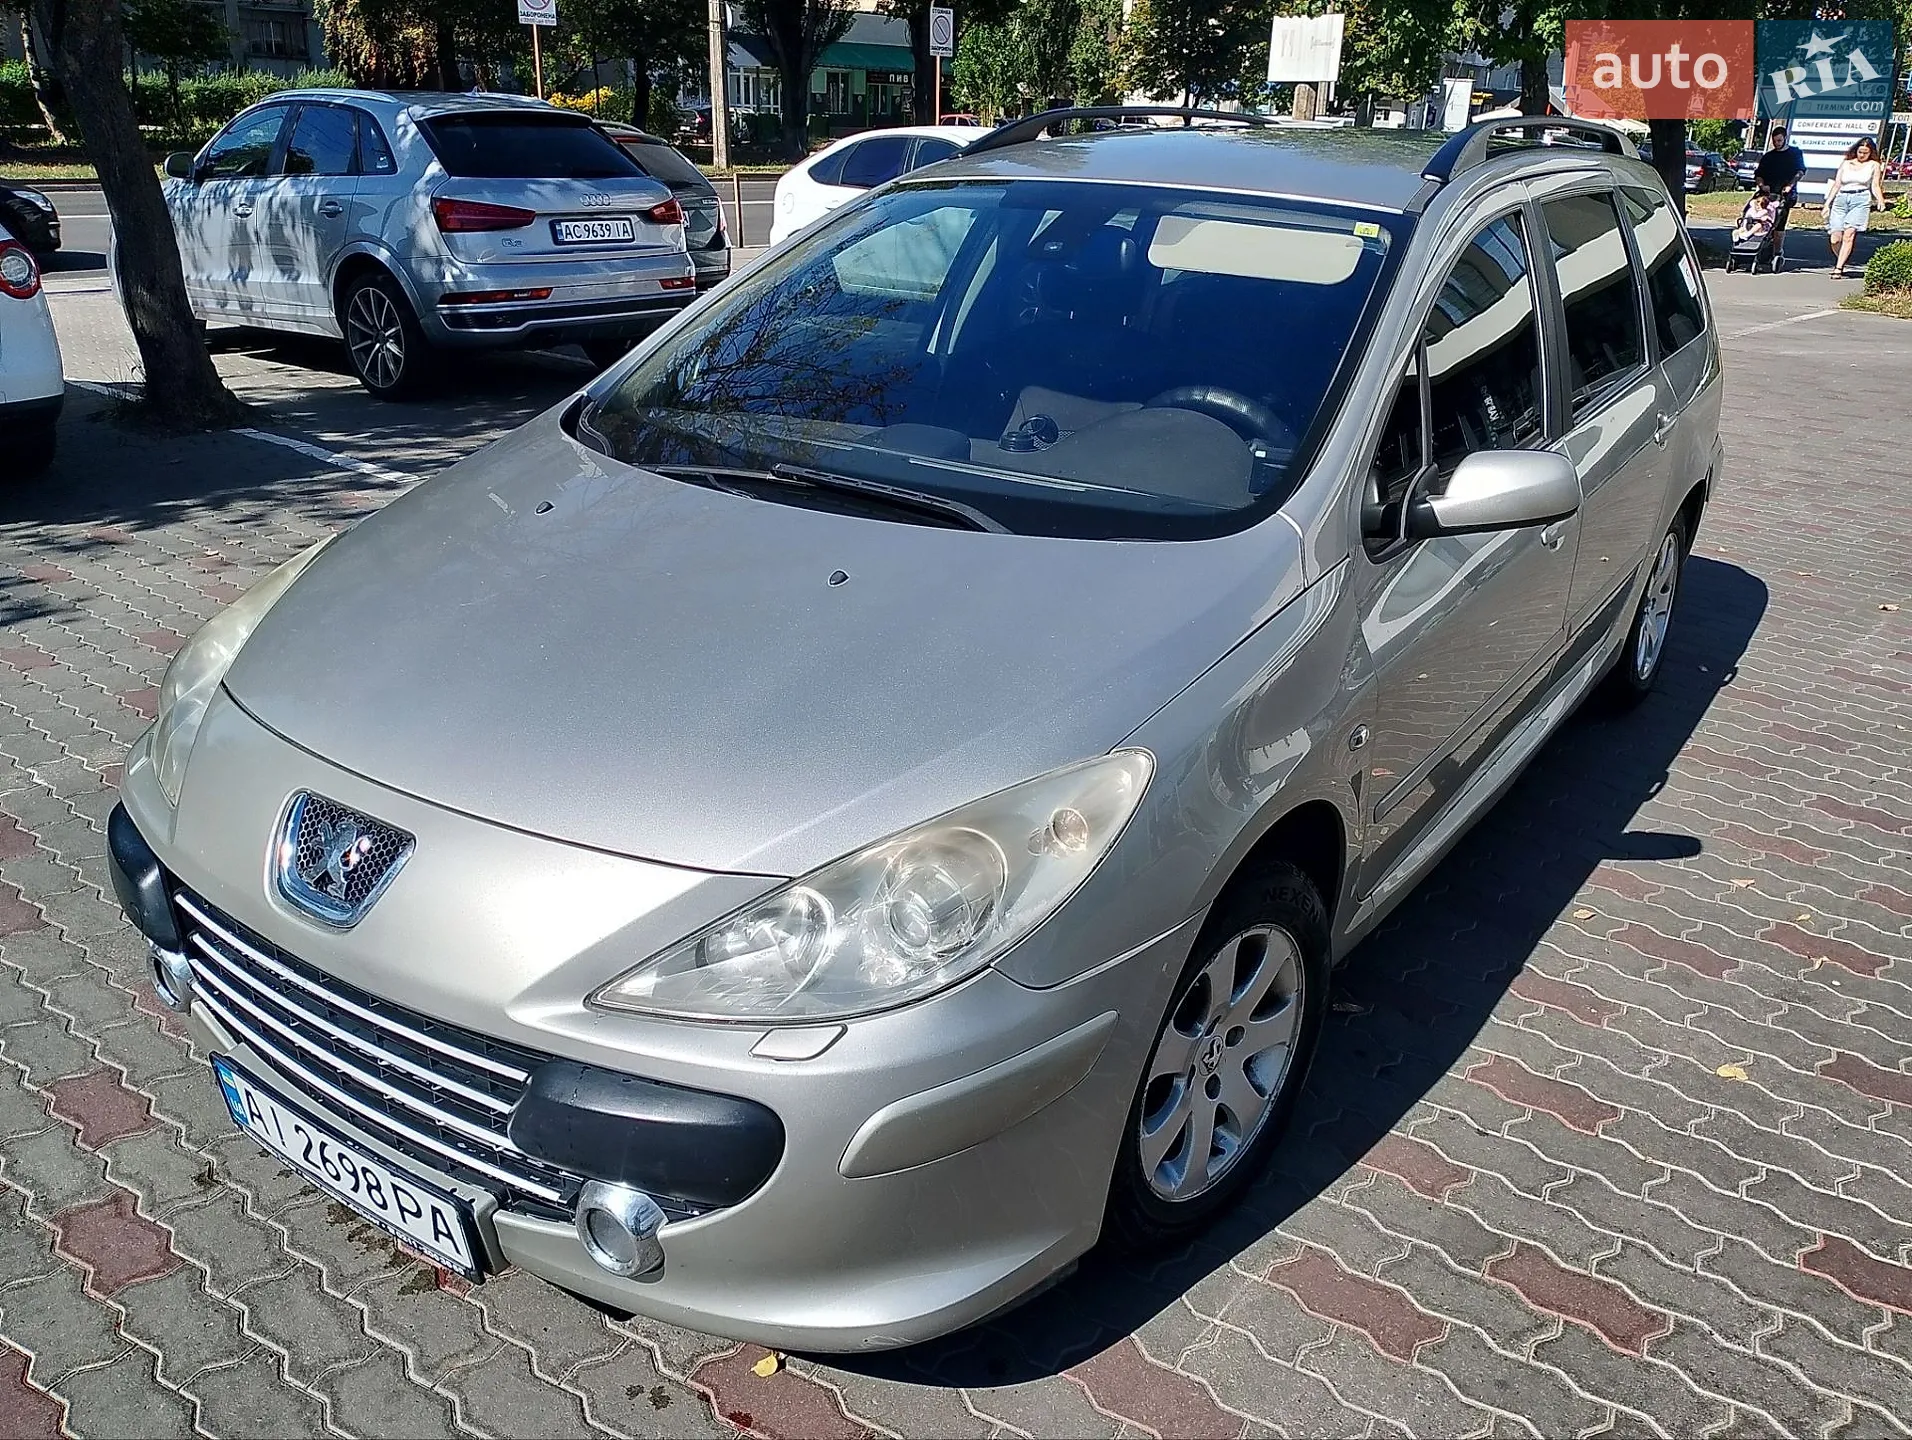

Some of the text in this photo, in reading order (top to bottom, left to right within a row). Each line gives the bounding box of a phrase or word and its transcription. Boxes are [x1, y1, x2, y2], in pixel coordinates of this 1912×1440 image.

[1797, 121, 1843, 129] CONFERENCE
[564, 222, 631, 240] AC 9639 IA
[1265, 886, 1320, 924] NEXEN
[244, 1088, 288, 1149] AI
[294, 1123, 388, 1211] 2698
[389, 1180, 462, 1256] PA
